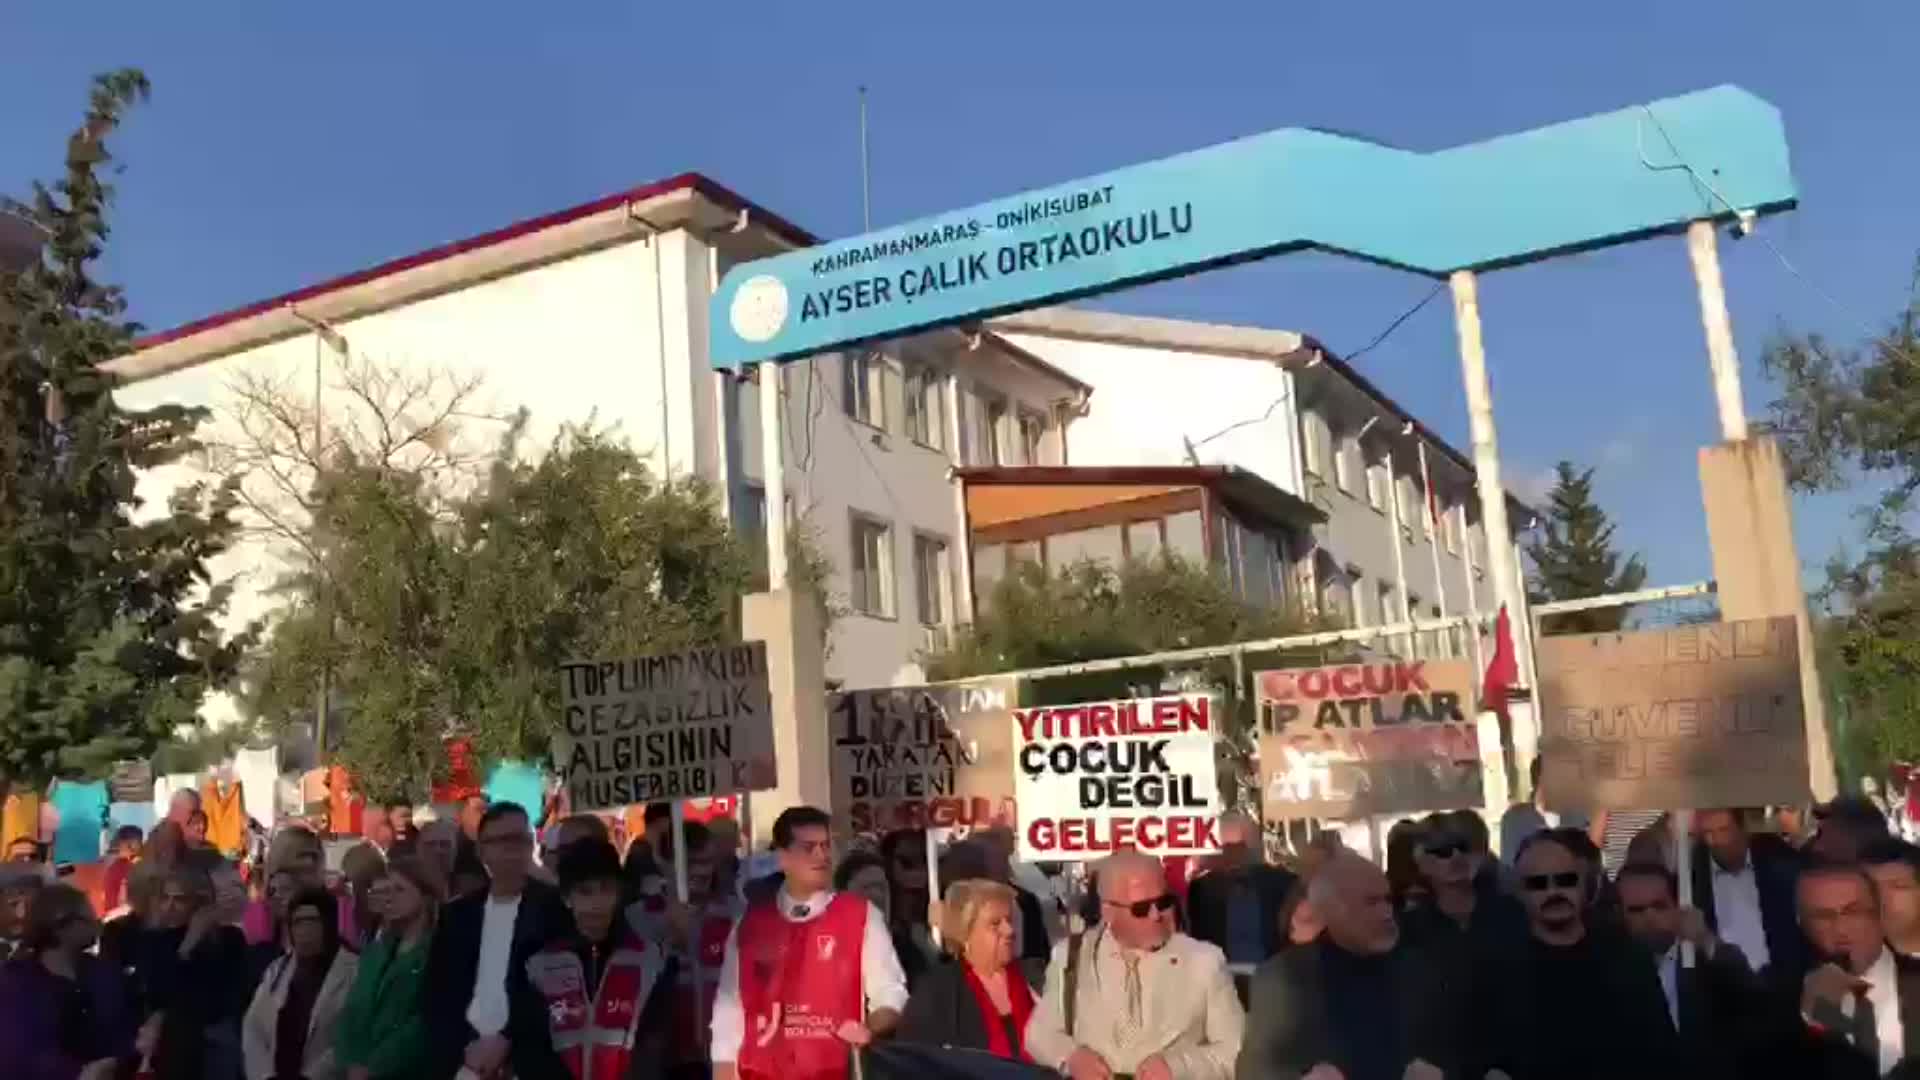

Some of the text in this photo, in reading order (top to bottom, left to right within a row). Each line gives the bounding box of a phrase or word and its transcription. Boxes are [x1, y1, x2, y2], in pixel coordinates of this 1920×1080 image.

[800, 201, 1192, 322] AYSER ÇALIK ORTAOKULU
[811, 218, 979, 277] KAHRAMANMARAŞ
[568, 724, 733, 778] ALGISININ
[1019, 740, 1171, 781] ÇOCUK
[1027, 816, 1222, 855] GELECEK
